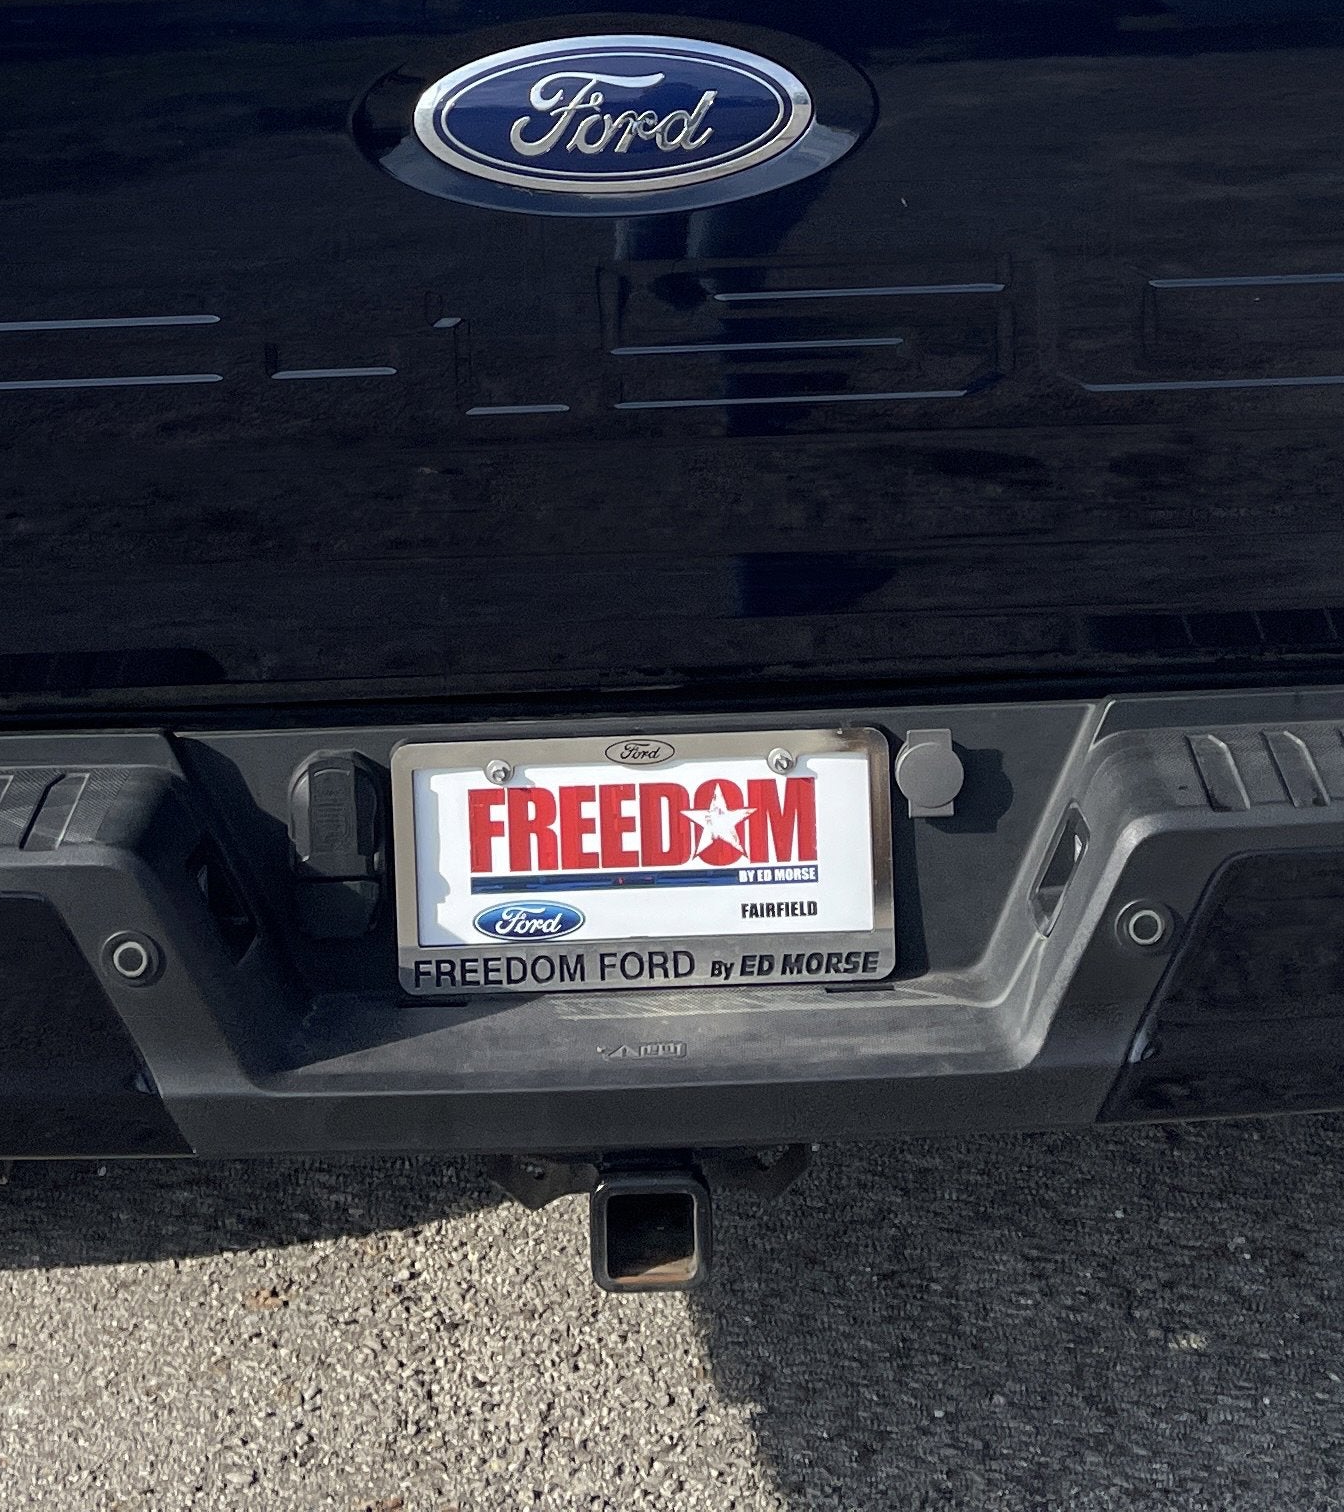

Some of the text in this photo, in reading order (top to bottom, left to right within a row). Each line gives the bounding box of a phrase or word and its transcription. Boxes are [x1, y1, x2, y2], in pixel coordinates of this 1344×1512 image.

[509, 71, 719, 156] Ford
[619, 743, 661, 759] Ford
[467, 776, 818, 873] FREEDOM
[738, 867, 817, 883] BY ED MORSE
[495, 907, 563, 935] Ford
[740, 900, 818, 919] FAIRFIELD
[413, 949, 880, 988] FREEDOM FORD By ED MORSE
